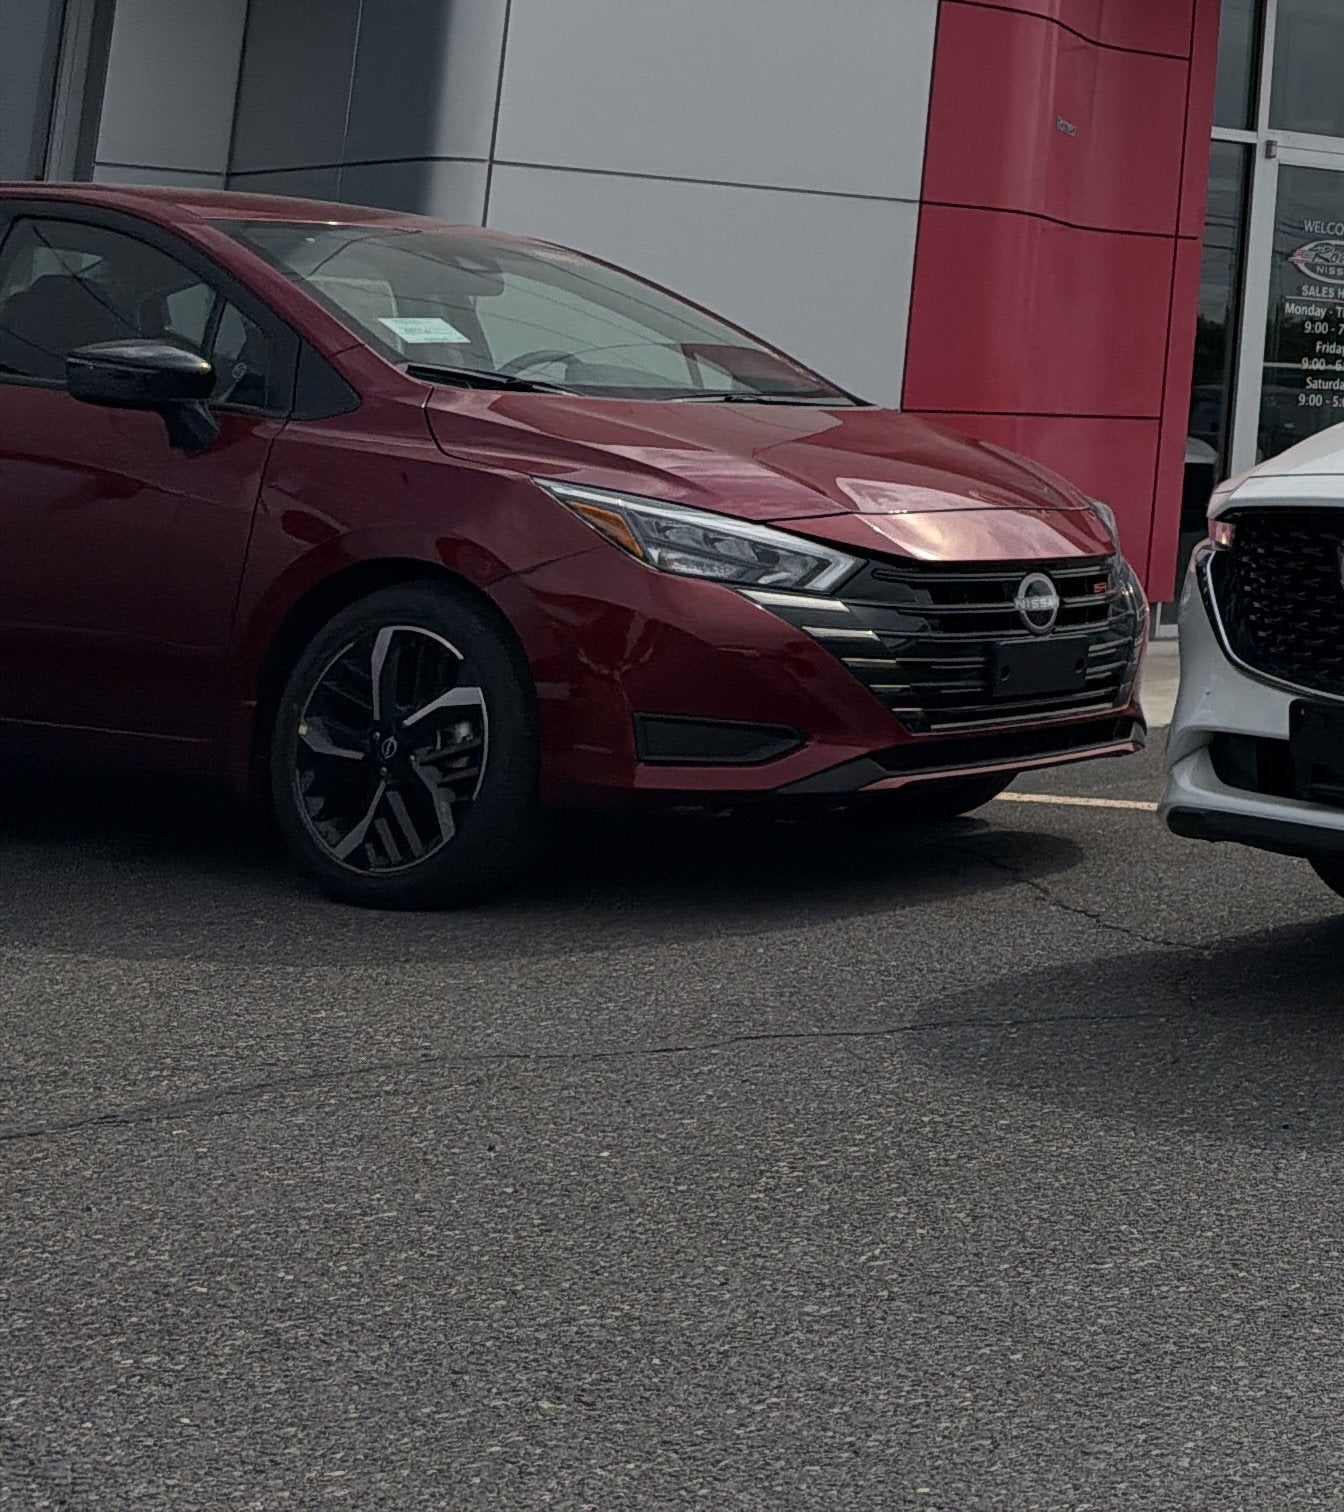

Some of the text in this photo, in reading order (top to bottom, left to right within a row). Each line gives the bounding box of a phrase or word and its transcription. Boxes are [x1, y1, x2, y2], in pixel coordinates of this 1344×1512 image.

[1302, 284, 1334, 298] SALES
[1285, 302, 1327, 319] Monday
[1304, 321, 1328, 334] 9:00
[1301, 357, 1325, 370] 9:00
[1298, 394, 1322, 406] 9:00
[1014, 598, 1058, 609] NISSA
